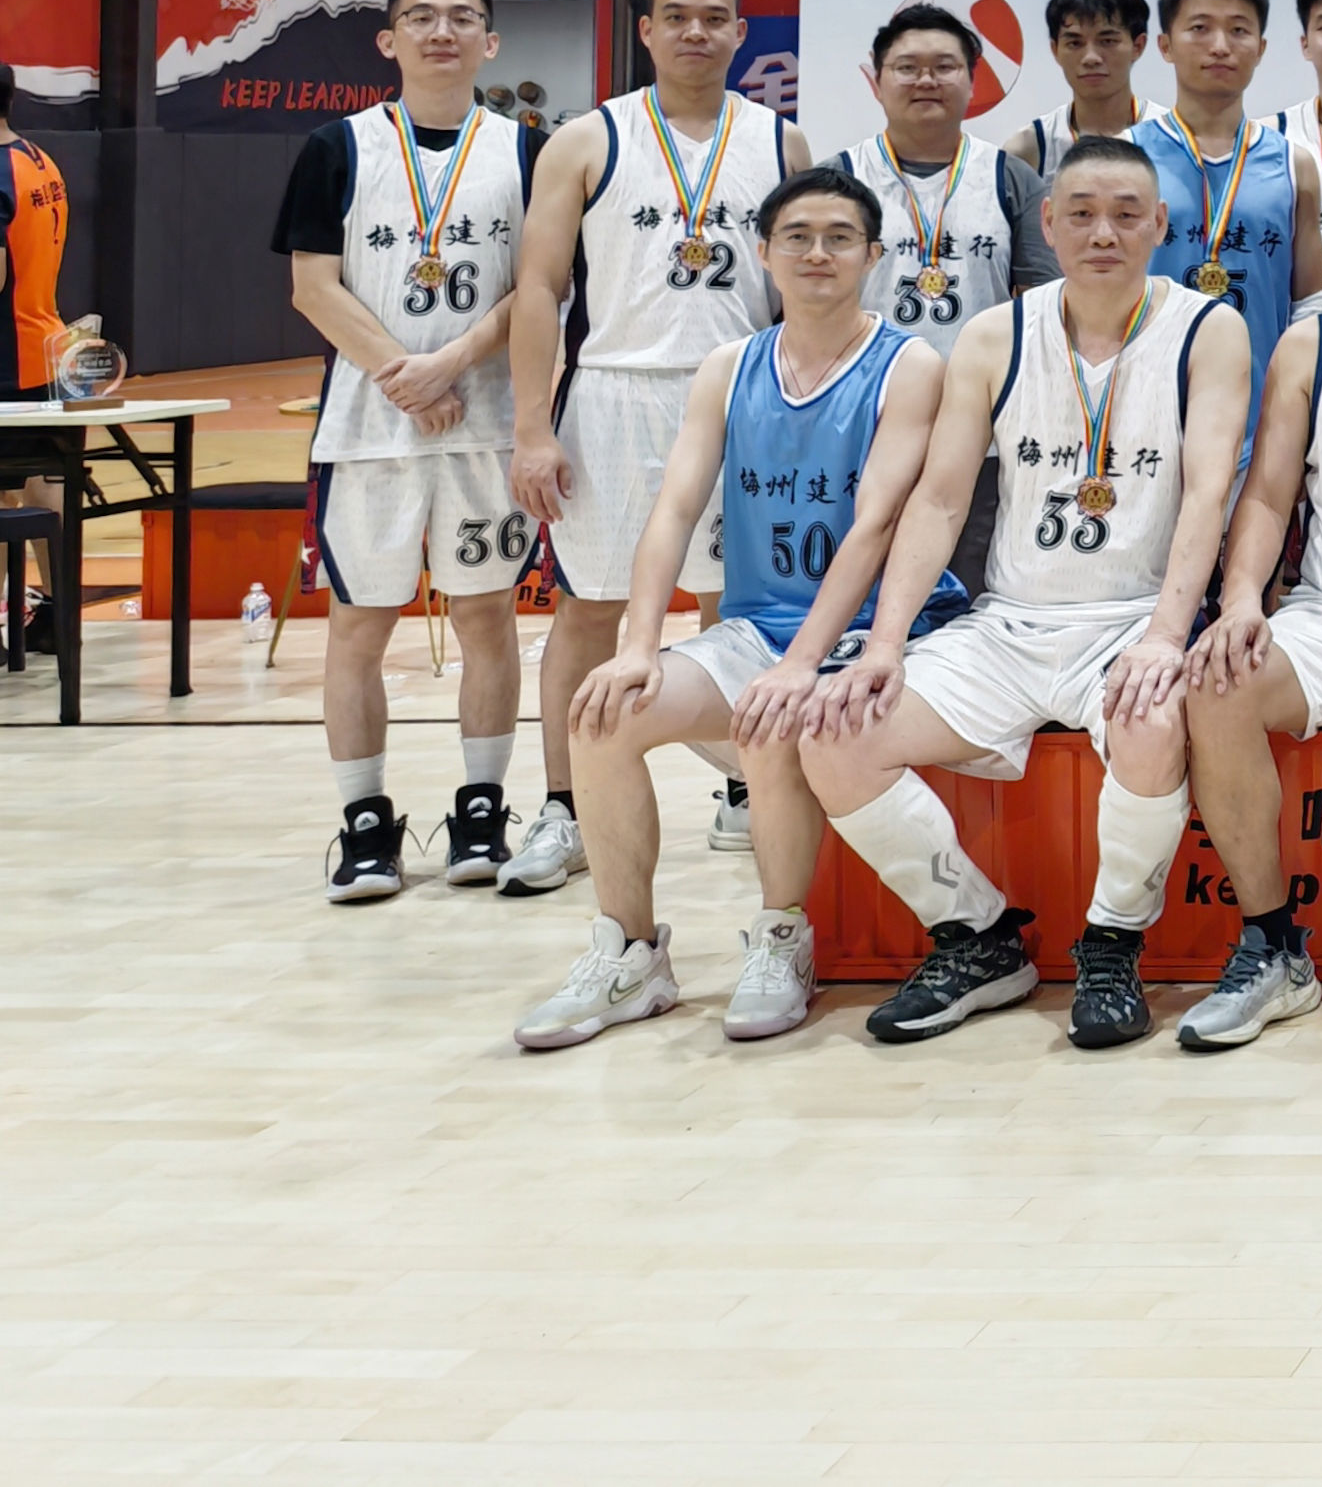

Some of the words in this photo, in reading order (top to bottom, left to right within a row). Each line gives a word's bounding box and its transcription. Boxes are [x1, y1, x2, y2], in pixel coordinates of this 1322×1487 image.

[221, 78, 281, 109] KEEP
[455, 511, 529, 568] 36
[771, 520, 837, 582] 50
